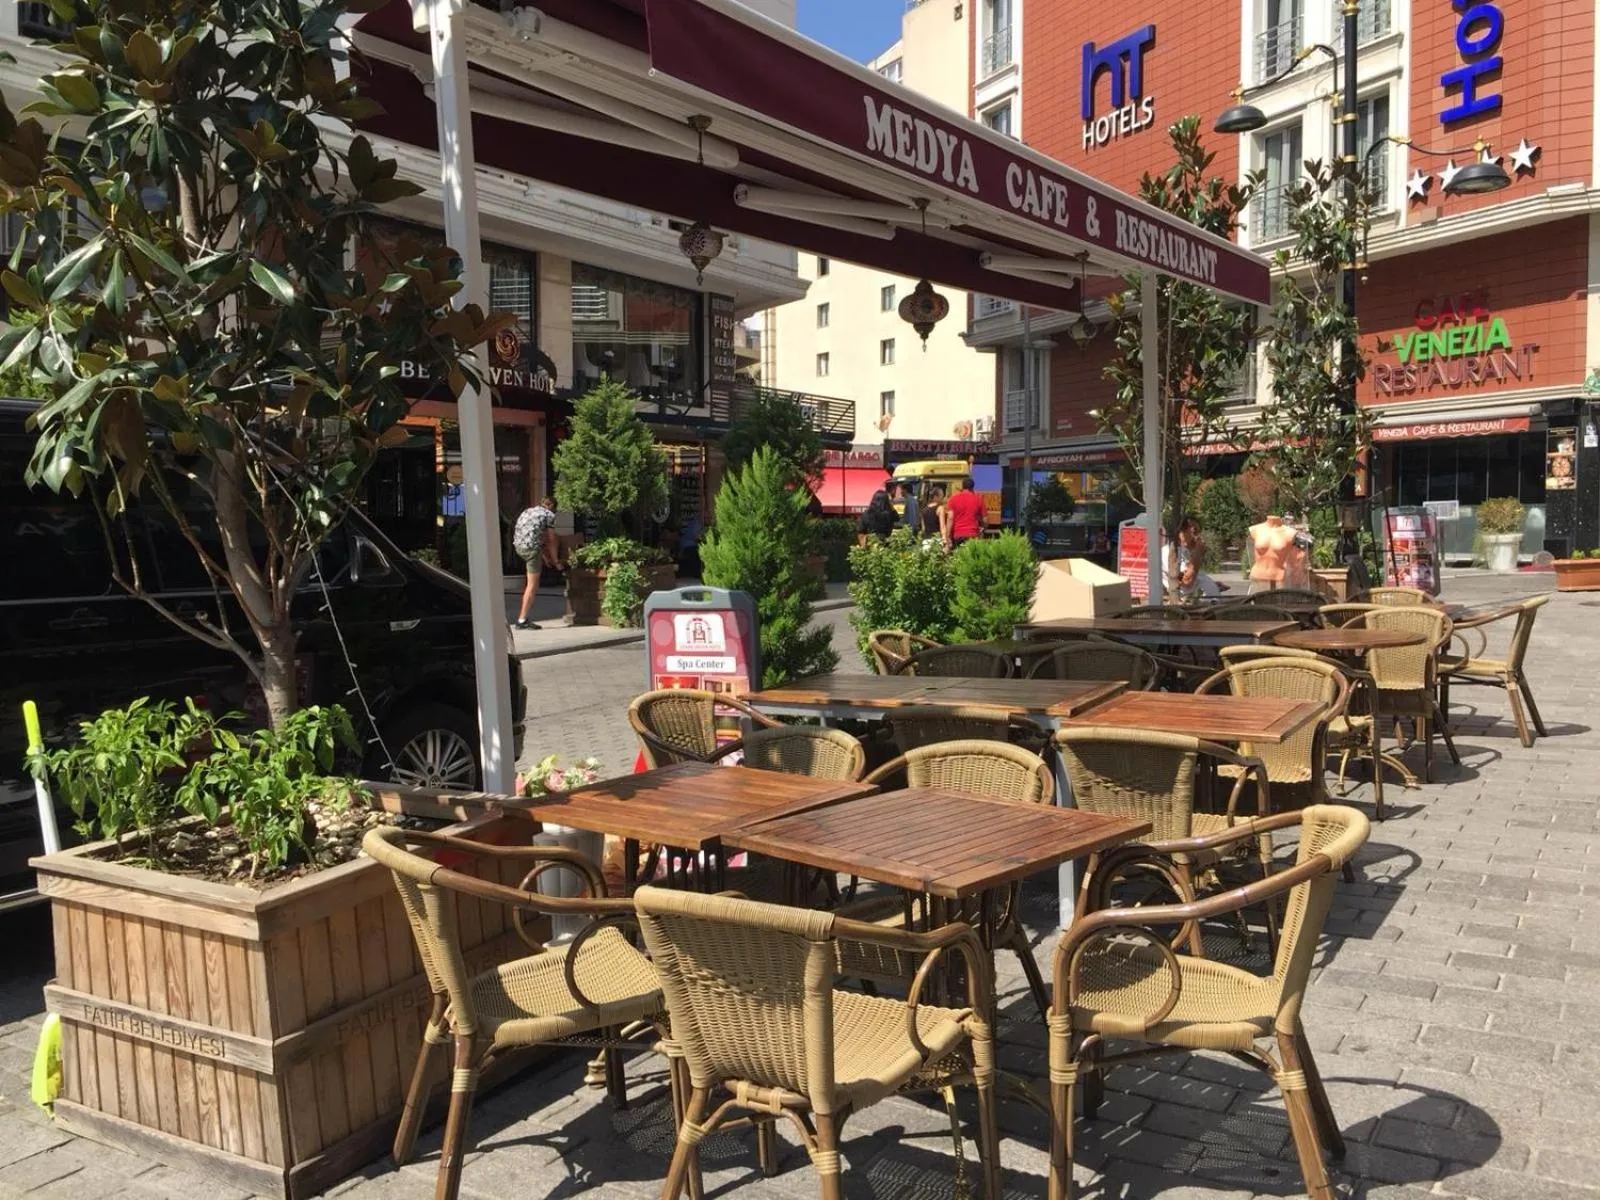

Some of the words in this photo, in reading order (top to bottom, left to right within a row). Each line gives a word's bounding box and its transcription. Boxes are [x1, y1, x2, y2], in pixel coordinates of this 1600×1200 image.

[1440, 0, 1503, 124] HO
[1082, 95, 1152, 150] HOTELS
[864, 95, 980, 193] MEDYA
[1005, 162, 1070, 227] CAFE
[1086, 195, 1100, 238] &
[1114, 209, 1219, 284] RESTAURANT
[1392, 317, 1512, 363] VENEZIA
[1372, 343, 1538, 395] RESTAURANT
[1447, 418, 1505, 433] RESTAURANT
[677, 659, 693, 670] Spa
[695, 659, 726, 669] Center
